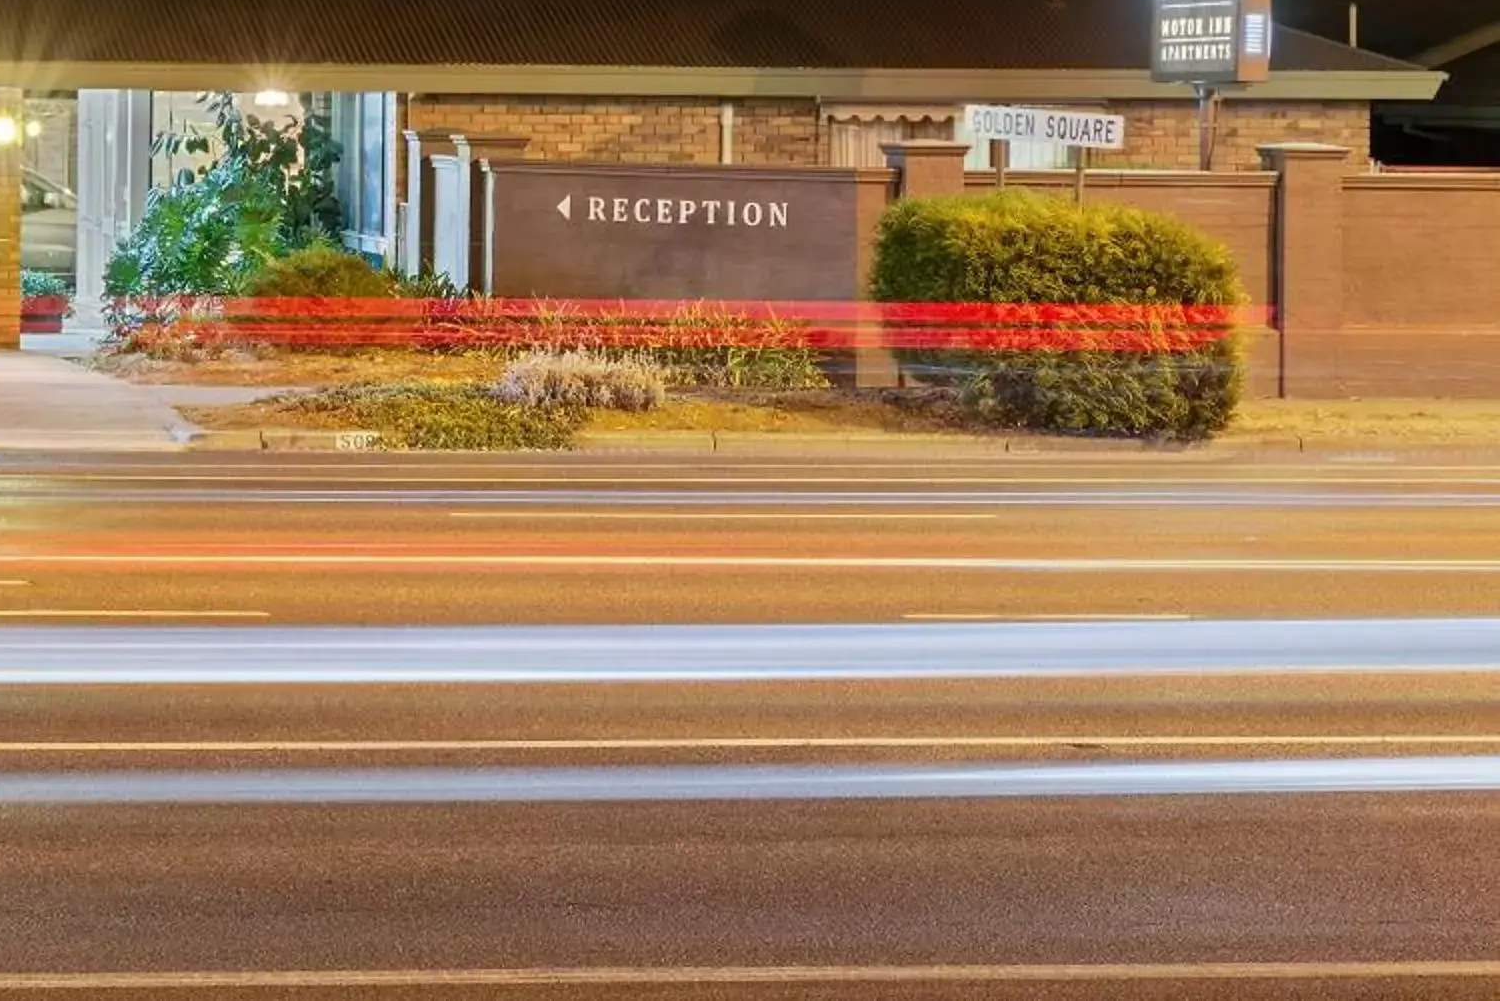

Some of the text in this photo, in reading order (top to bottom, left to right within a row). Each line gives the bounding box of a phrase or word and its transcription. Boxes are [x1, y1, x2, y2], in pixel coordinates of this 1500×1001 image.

[1161, 16, 1231, 37] MOTOR INN
[1161, 44, 1232, 61] APARTMENTS
[972, 110, 1116, 145] GOLDEN SQUARE
[587, 196, 789, 228] RECEPTION
